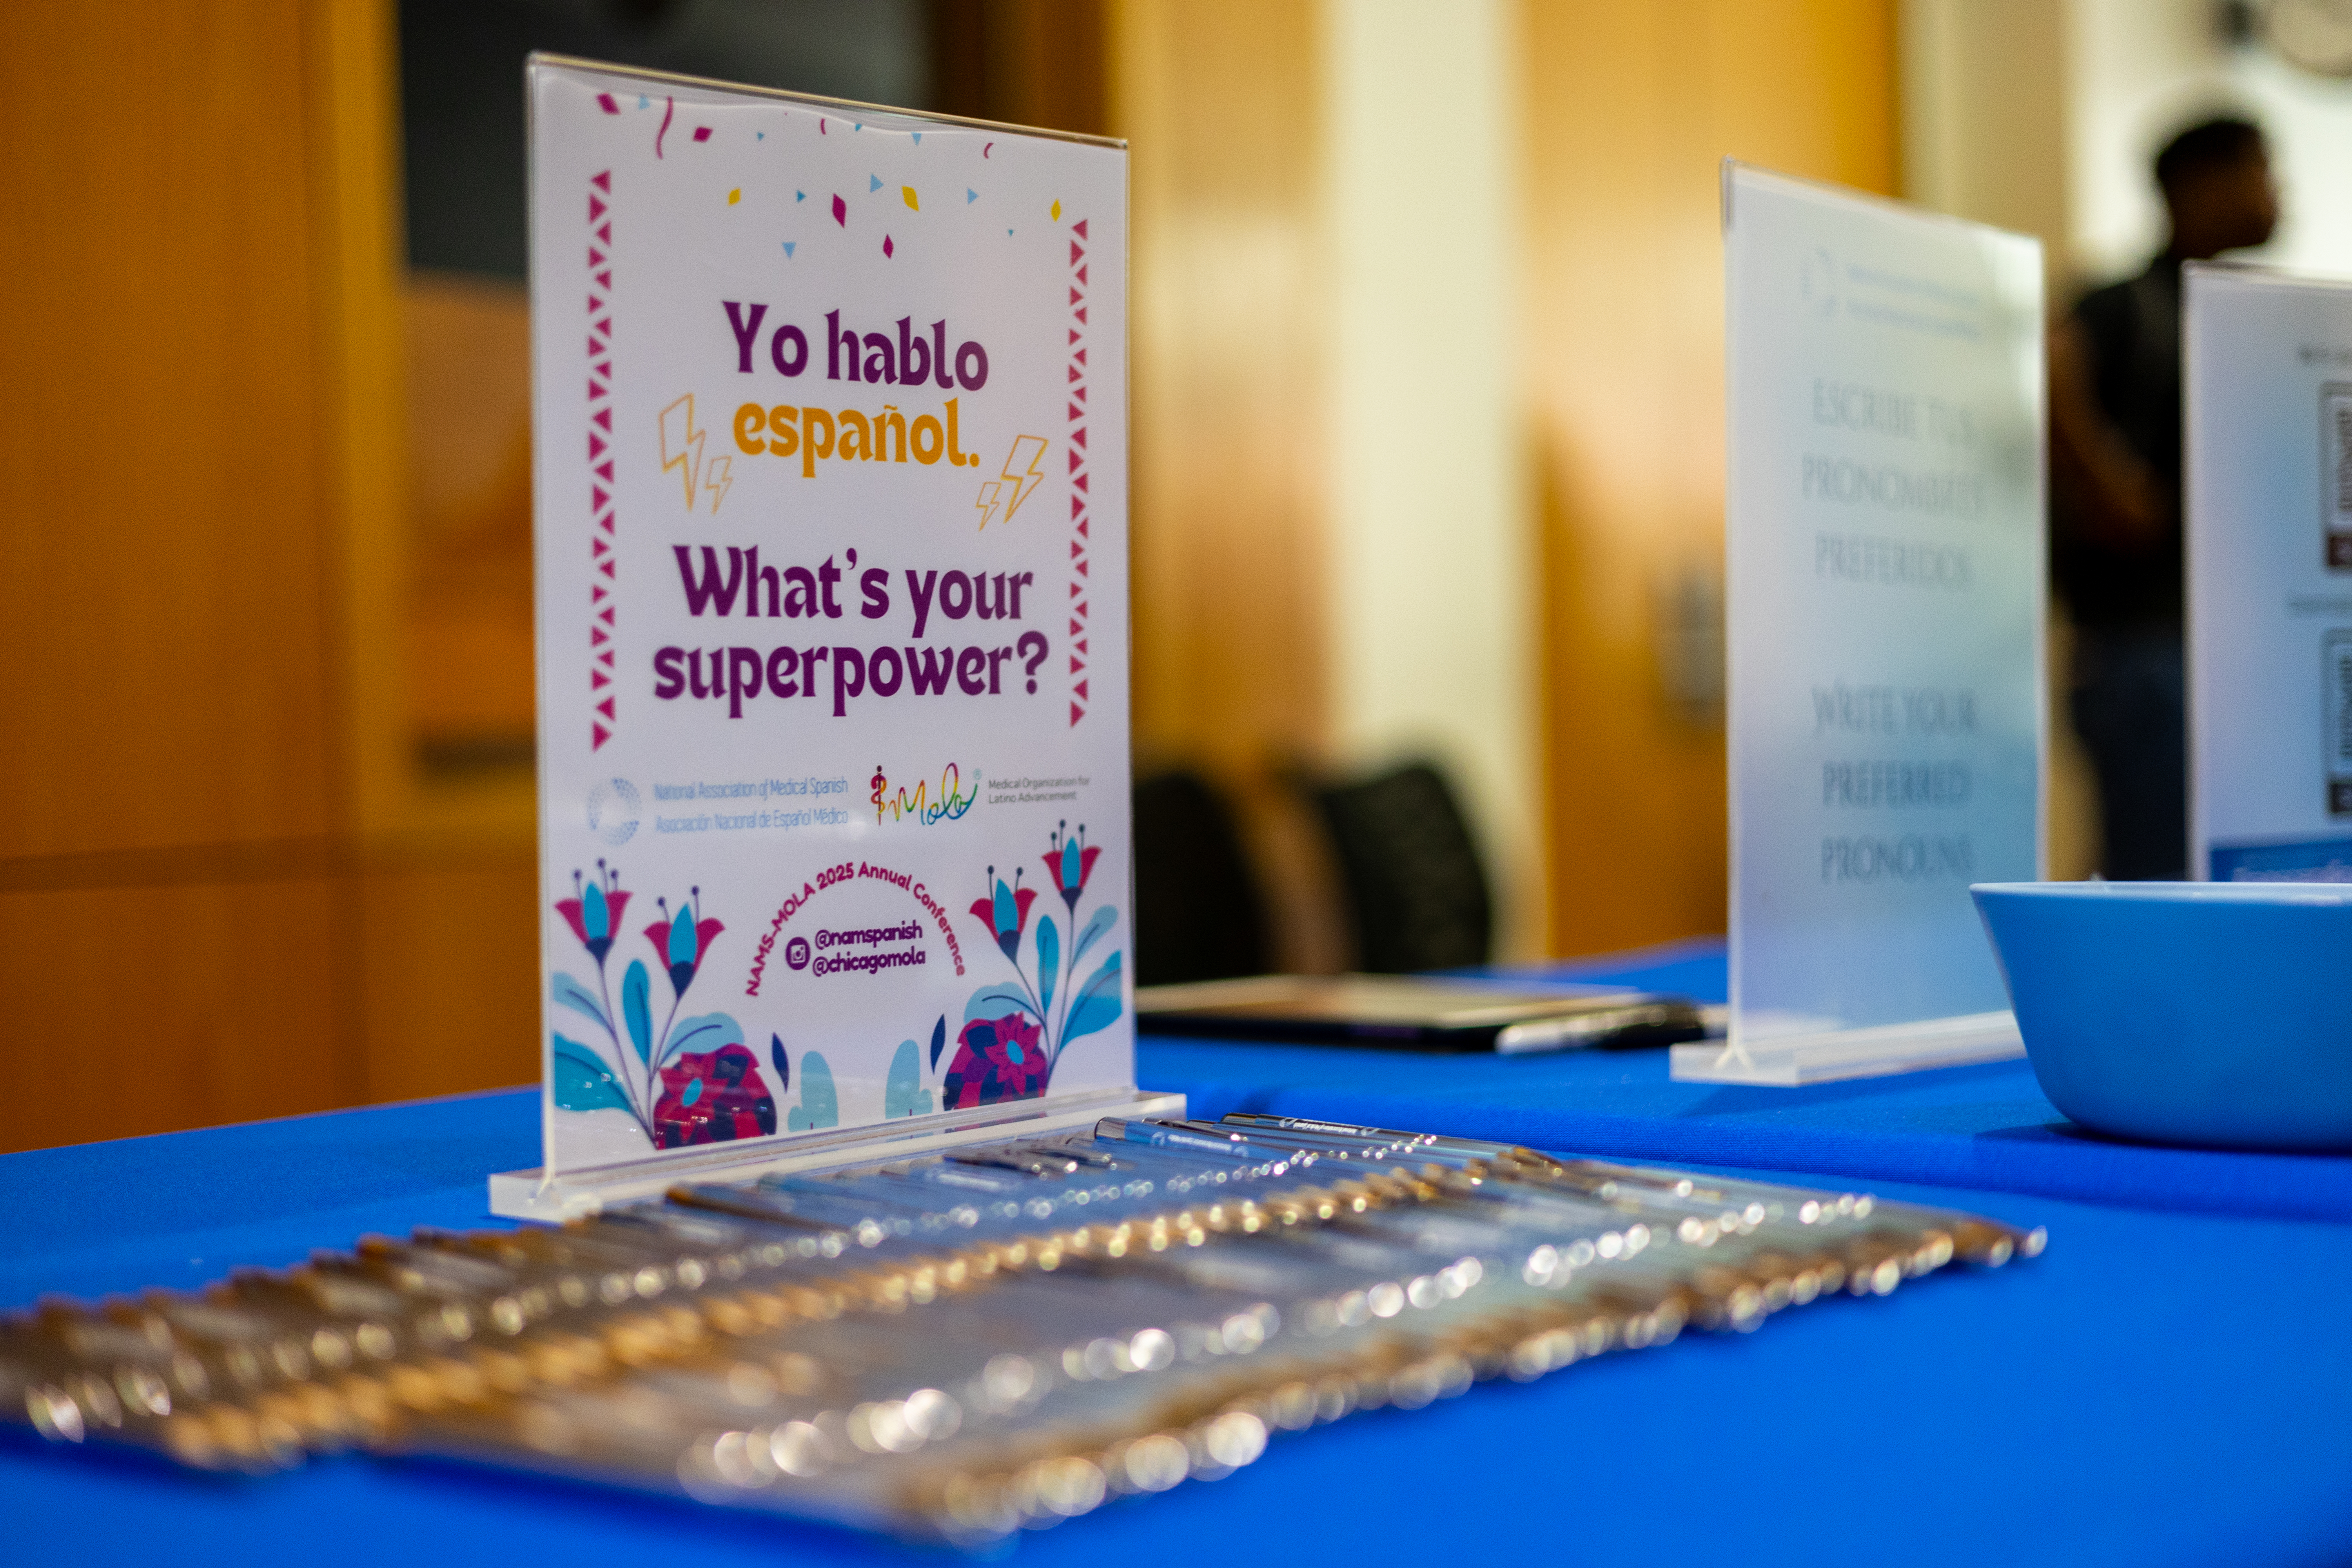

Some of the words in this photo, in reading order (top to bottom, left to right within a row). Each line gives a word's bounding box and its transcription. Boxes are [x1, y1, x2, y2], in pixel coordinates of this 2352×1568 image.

[722, 300, 809, 377] Yo
[824, 308, 989, 392] hablo
[1812, 377, 1918, 440] ESCRIBE
[733, 396, 980, 478] español.
[672, 544, 890, 619] What's
[905, 570, 1034, 638] your
[653, 630, 1049, 719] superpower?
[1811, 678, 1894, 738] WRITE
[654, 782, 695, 800] National
[698, 781, 757, 799] Association
[759, 779, 769, 801] of
[770, 778, 808, 795] Medical
[809, 776, 848, 798] Spanish
[988, 778, 1020, 789] Medical
[1022, 778, 1077, 790] Organization
[1078, 776, 1091, 786] for
[988, 794, 1016, 804] Latino
[1018, 791, 1077, 802] Advancement
[1822, 759, 1973, 808] PREFERRED
[656, 813, 711, 833] Asociación
[714, 811, 757, 830] Nacional
[759, 811, 771, 828] de
[773, 808, 812, 831] Español
[814, 806, 848, 824] Médico
[815, 920, 923, 950] @namspanish
[816, 862, 855, 890] 2025
[858, 861, 913, 892] Annual
[913, 883, 965, 976] Conference
[813, 946, 926, 977] @chicagomola
